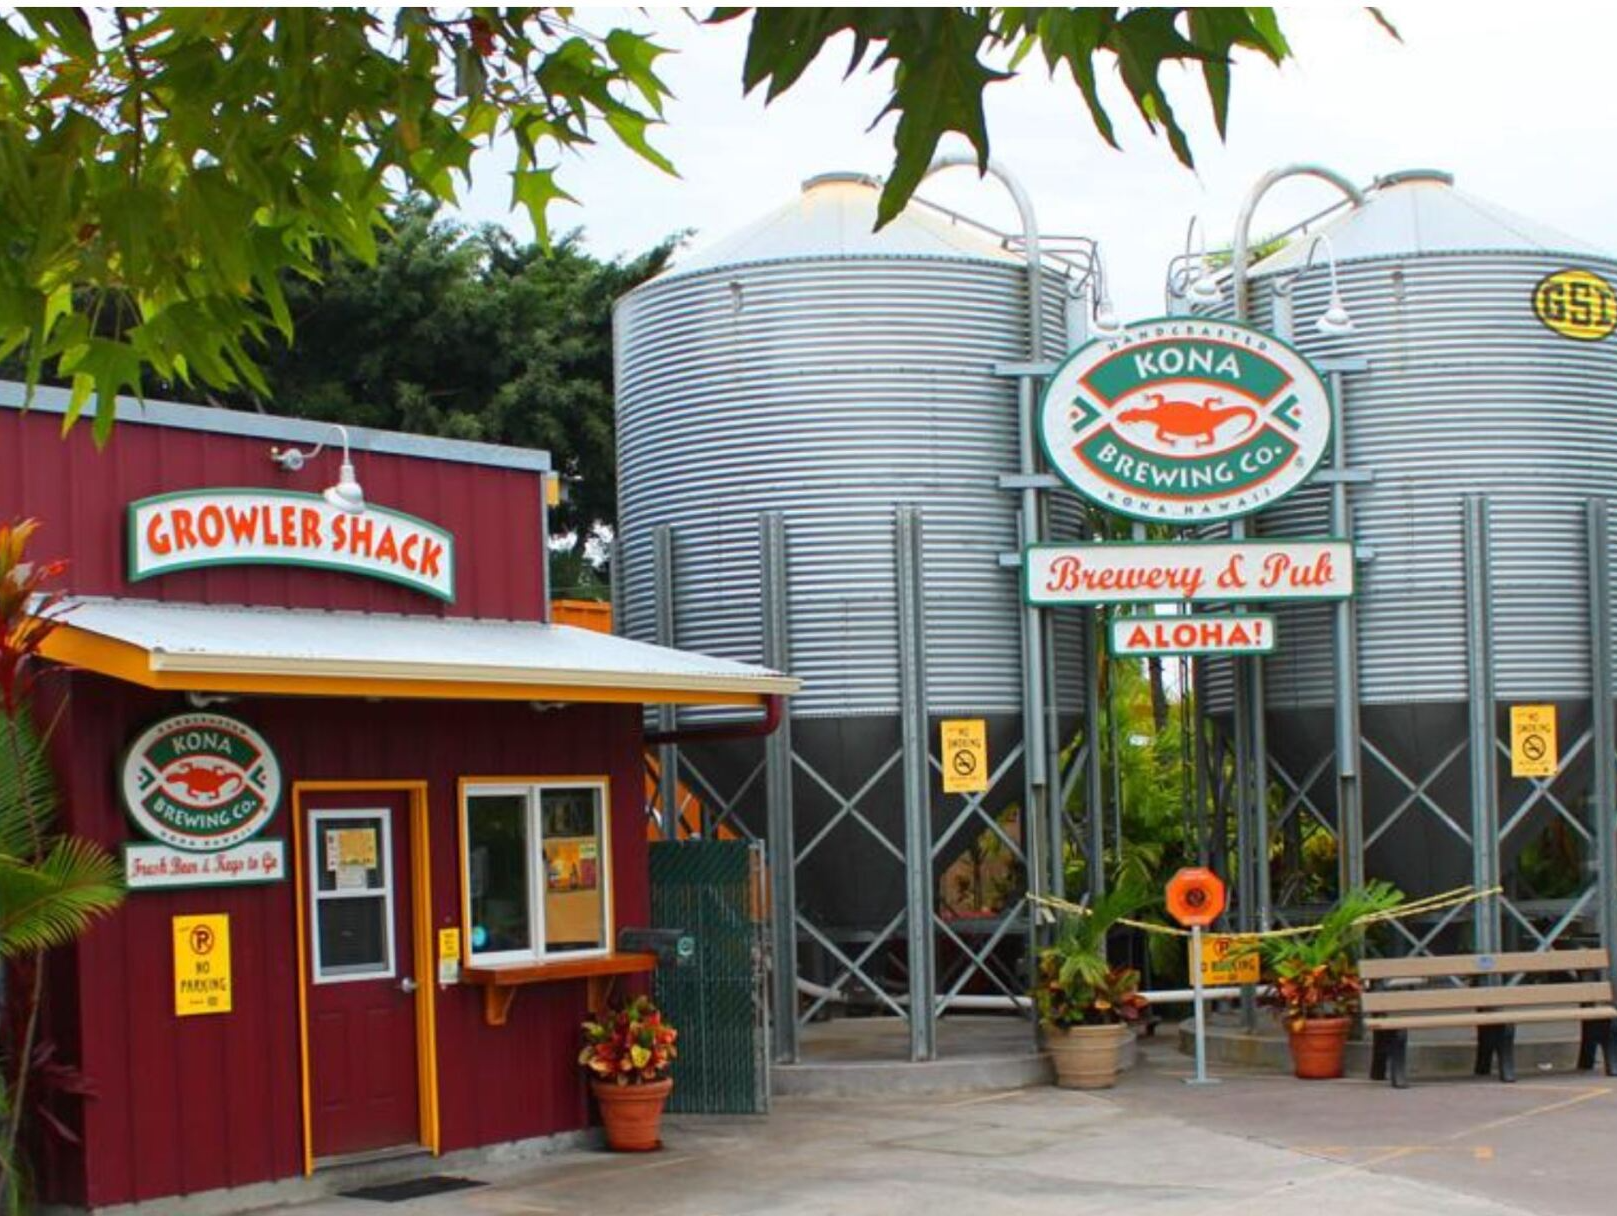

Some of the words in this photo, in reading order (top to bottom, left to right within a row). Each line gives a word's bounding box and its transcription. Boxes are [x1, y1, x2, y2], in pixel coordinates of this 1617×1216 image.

[1107, 325, 1269, 351] HANDCRAFTED
[1133, 347, 1241, 379] KONA
[1096, 442, 1234, 488] BREWING
[1240, 446, 1283, 472] CO.
[1107, 491, 1168, 513] KONA
[146, 504, 323, 555] GROWLER
[331, 511, 444, 578] SHACK
[1045, 554, 1206, 599] Brewery
[1216, 554, 1248, 588] &
[1259, 551, 1336, 588] Pub
[1127, 621, 1264, 648] ALOHA!
[171, 732, 233, 754] KONA
[153, 797, 230, 828] BREWING
[232, 800, 258, 820] CO.
[195, 961, 210, 974] NO
[181, 978, 227, 994] PARKING
